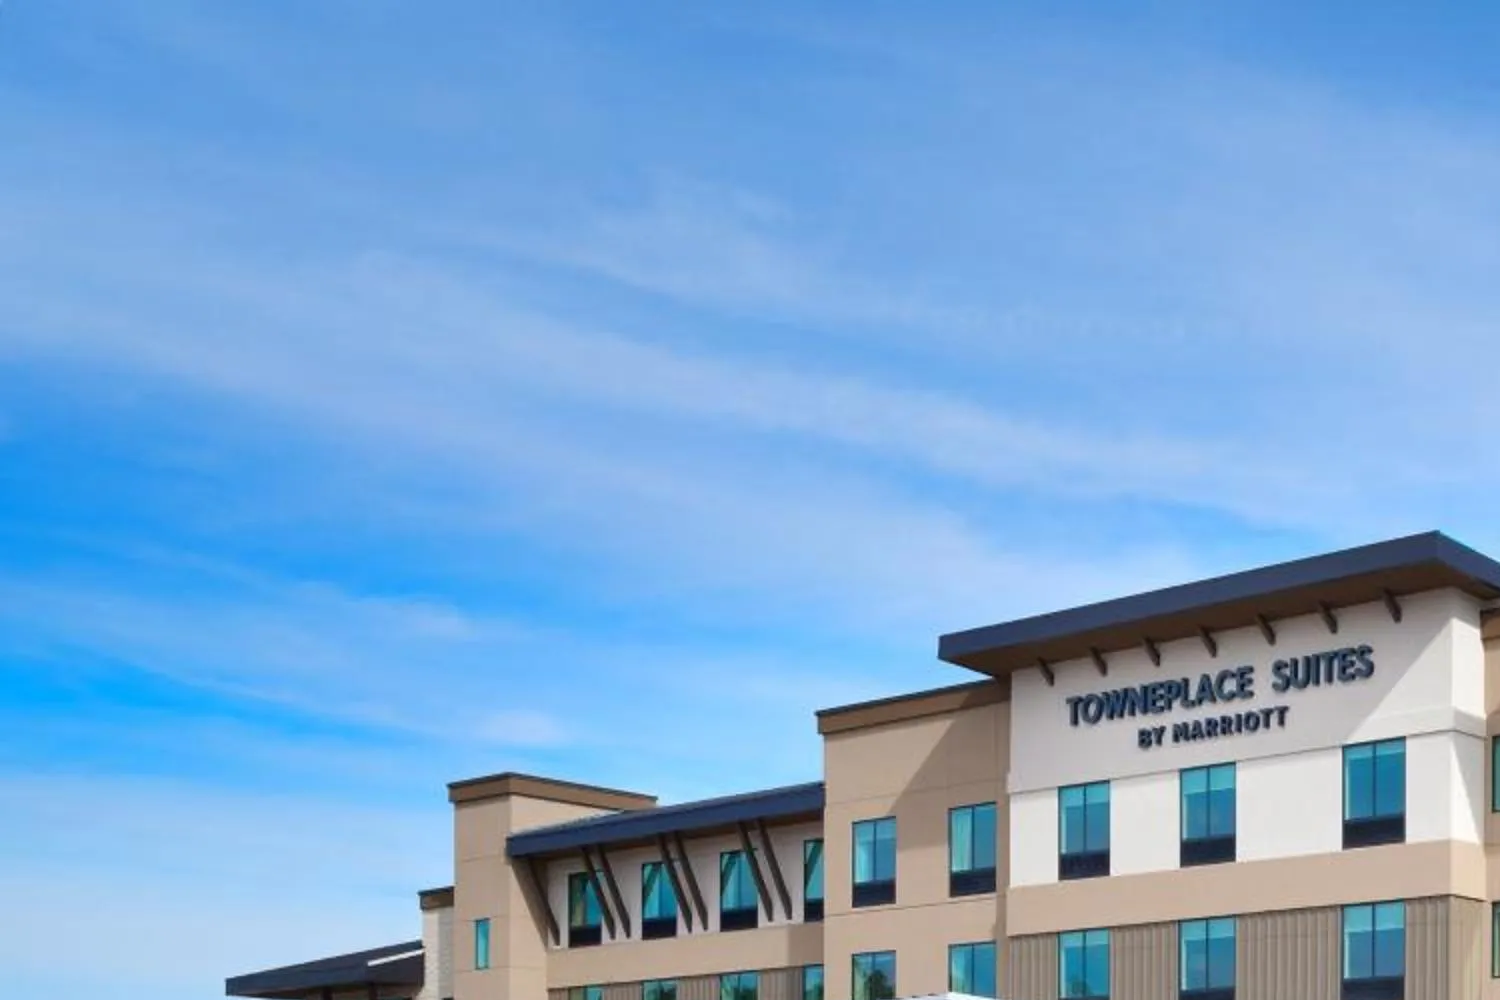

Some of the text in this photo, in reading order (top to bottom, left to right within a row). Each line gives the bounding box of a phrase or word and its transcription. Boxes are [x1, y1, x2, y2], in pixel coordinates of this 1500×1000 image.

[1066, 645, 1375, 727] TOWNEPLACE SUITES
[1138, 706, 1289, 750] BY MARRIOTT
